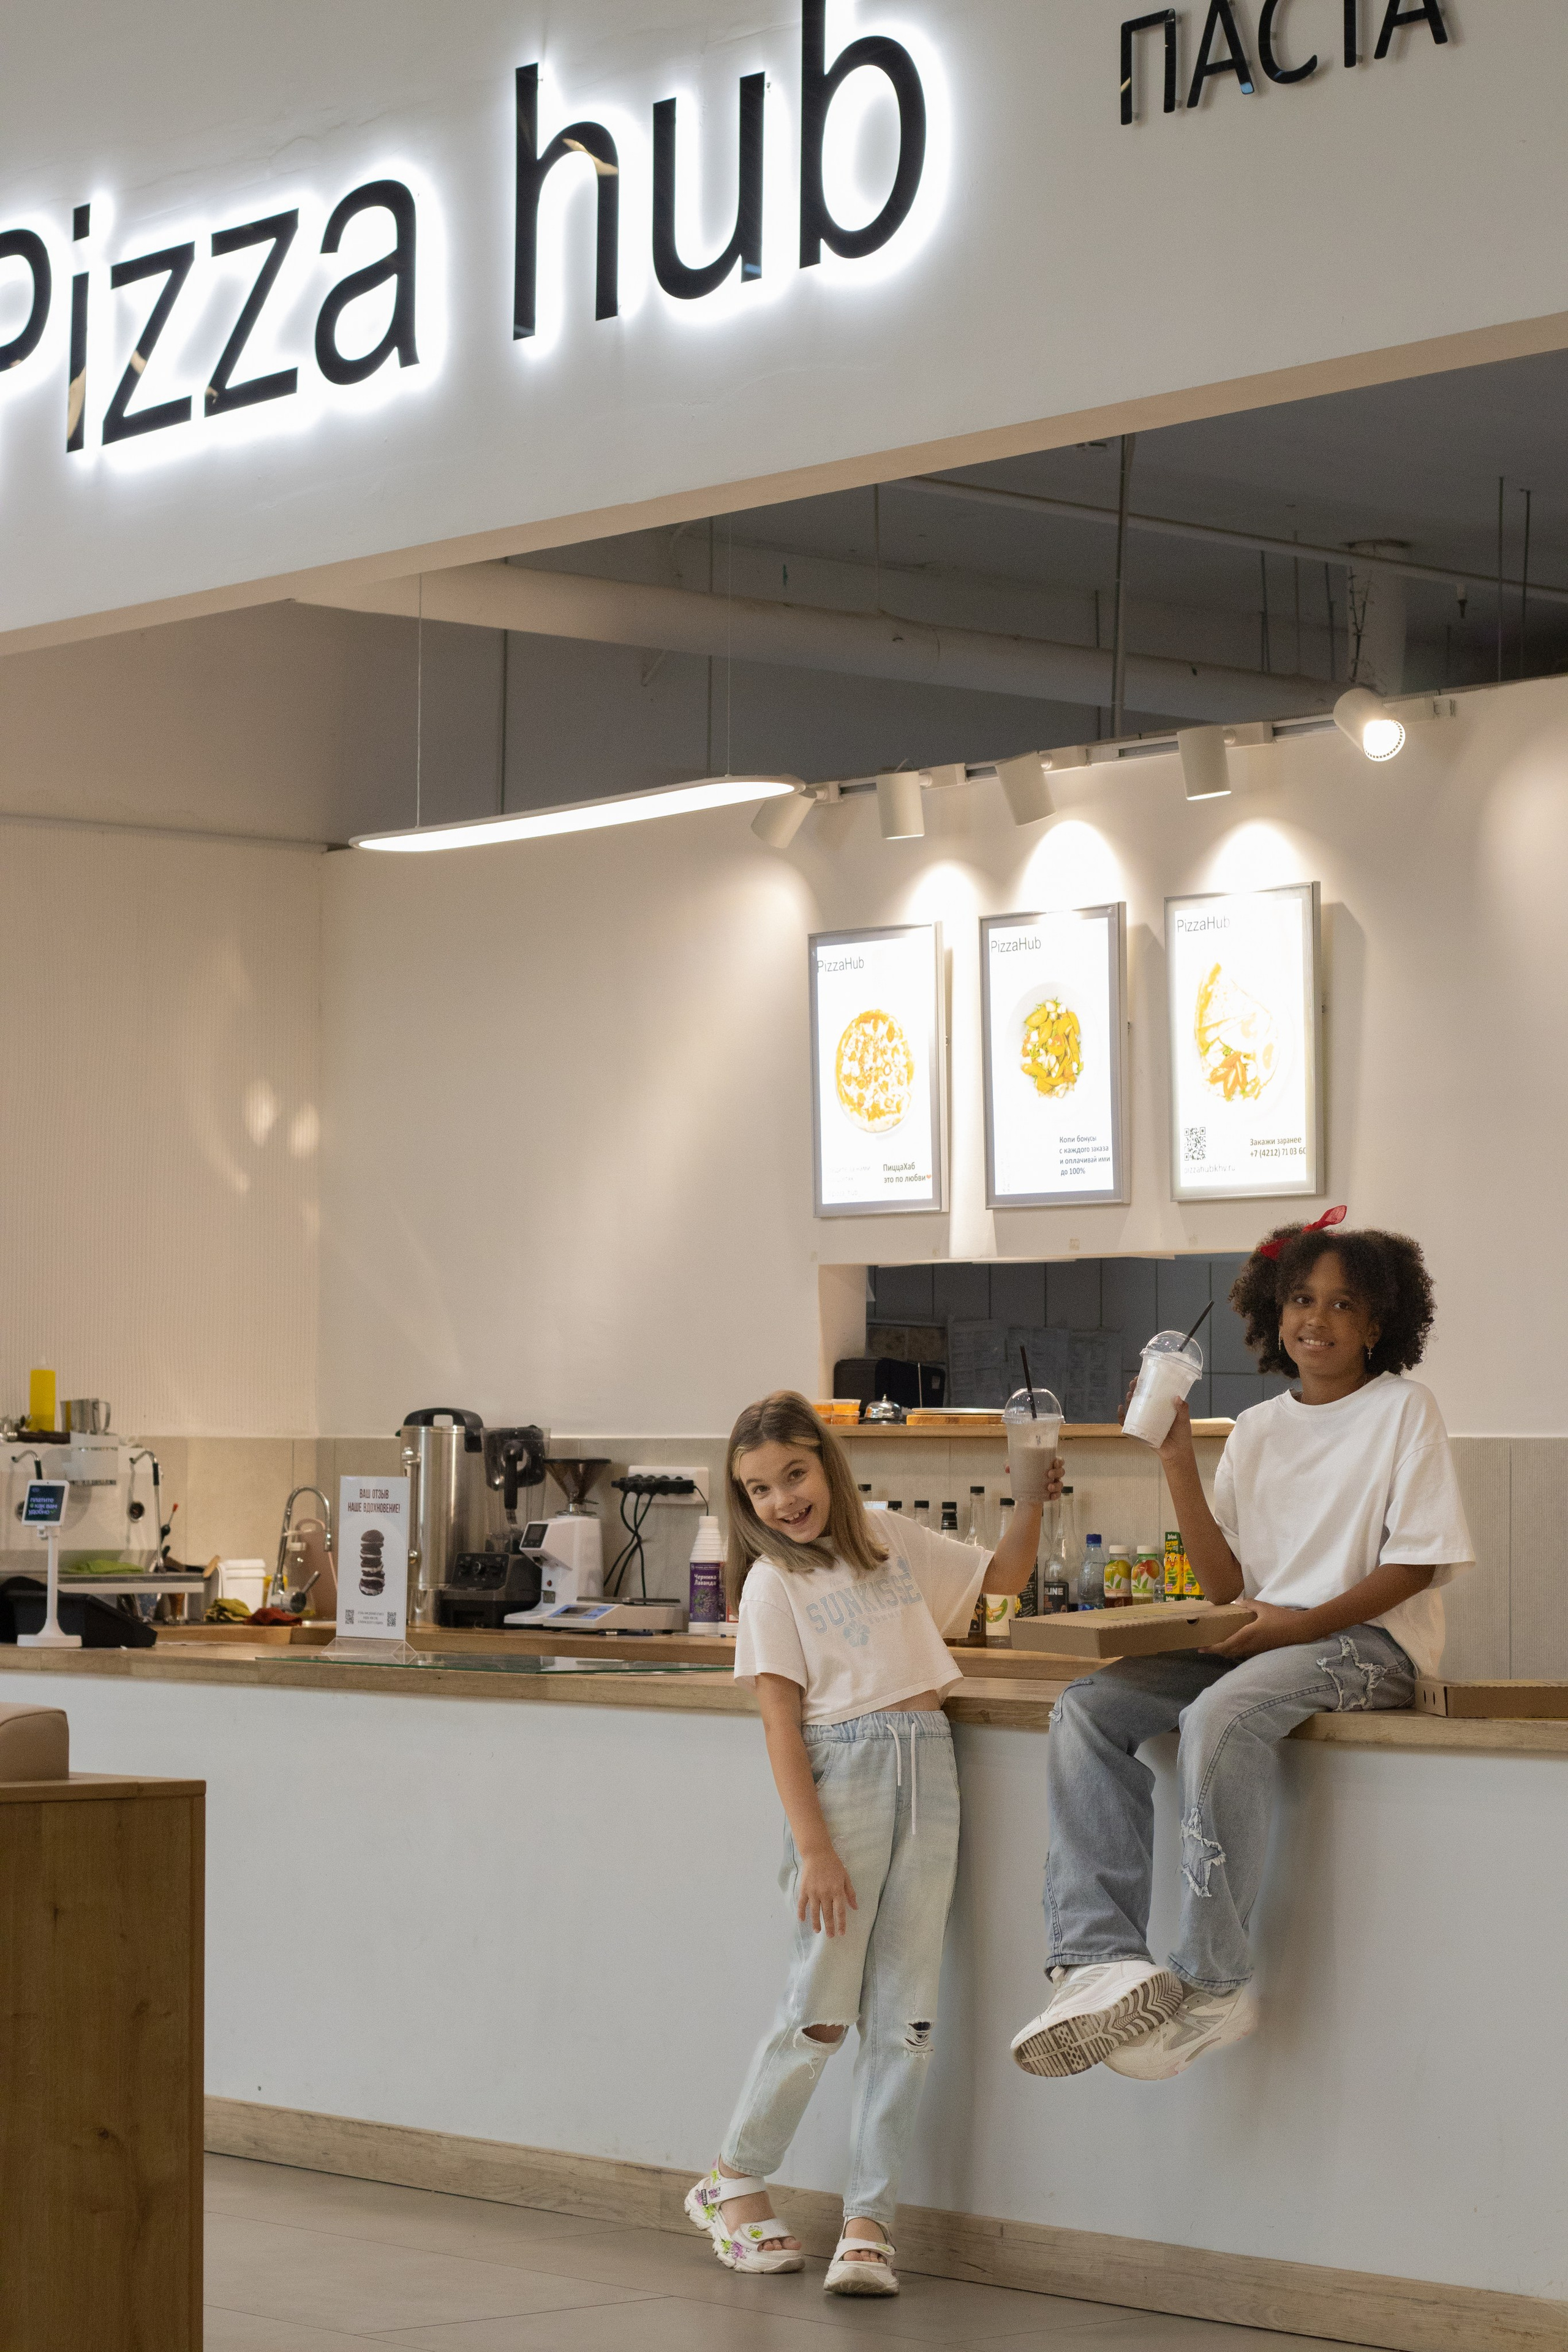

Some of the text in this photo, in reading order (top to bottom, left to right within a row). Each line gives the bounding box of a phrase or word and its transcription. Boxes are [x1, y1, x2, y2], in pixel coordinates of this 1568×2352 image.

[513, 0, 927, 341] hub
[1177, 916, 1230, 932] PizzaHub
[991, 936, 1041, 953] PizzaHub
[817, 956, 864, 973] PizzaHub
[1259, 1148, 1280, 1158] (4212)
[1065, 1156, 1097, 1164] оплачивай
[883, 1162, 915, 1172] ПиццаХаб
[905, 1174, 925, 1182] любви
[360, 1489, 389, 1499] ВАШ ОТЗЫВ
[348, 1502, 400, 1513] НАШЕ ВДОХНОВЕНИЕ!
